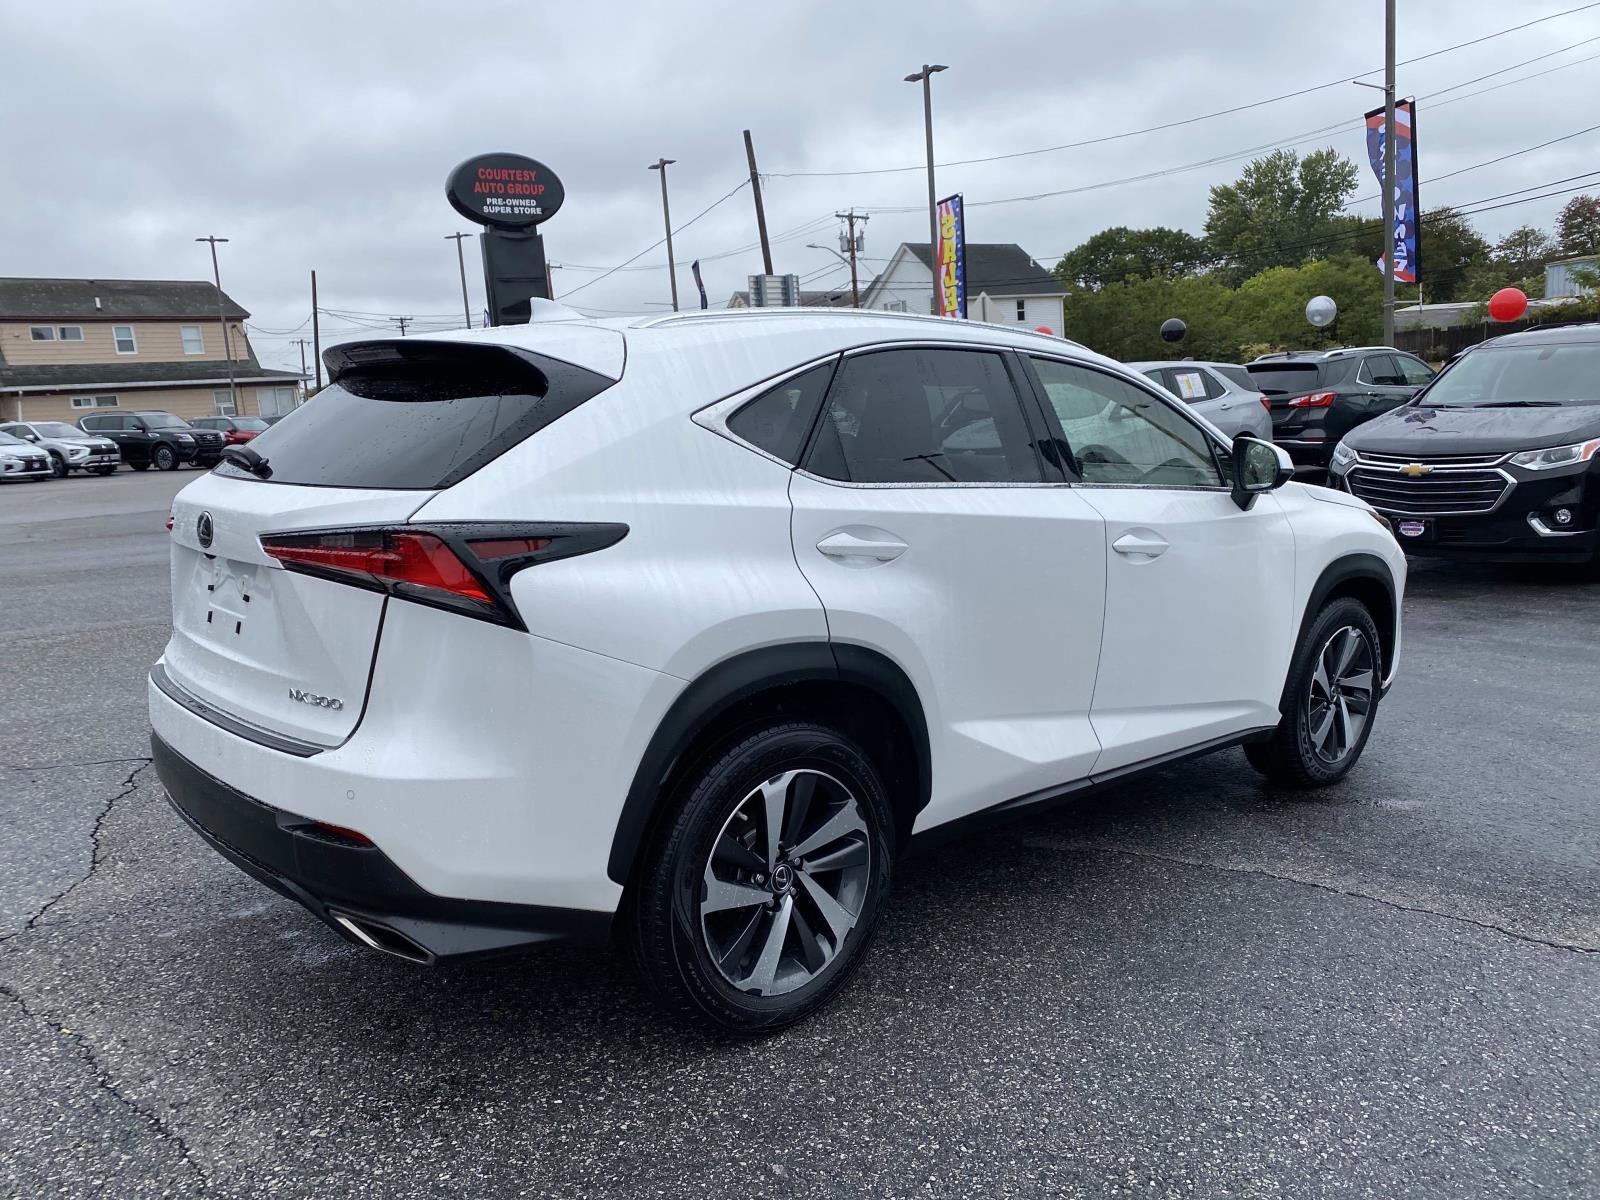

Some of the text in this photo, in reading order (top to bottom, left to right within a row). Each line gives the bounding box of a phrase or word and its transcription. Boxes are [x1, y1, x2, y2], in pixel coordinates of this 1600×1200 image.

[478, 168, 537, 181] COURTESY
[474, 182, 545, 195] AUTO GROUP
[486, 198, 537, 207] PRE-OWNED
[483, 206, 542, 215] SUPER STORE
[289, 688, 345, 712] NX 300
